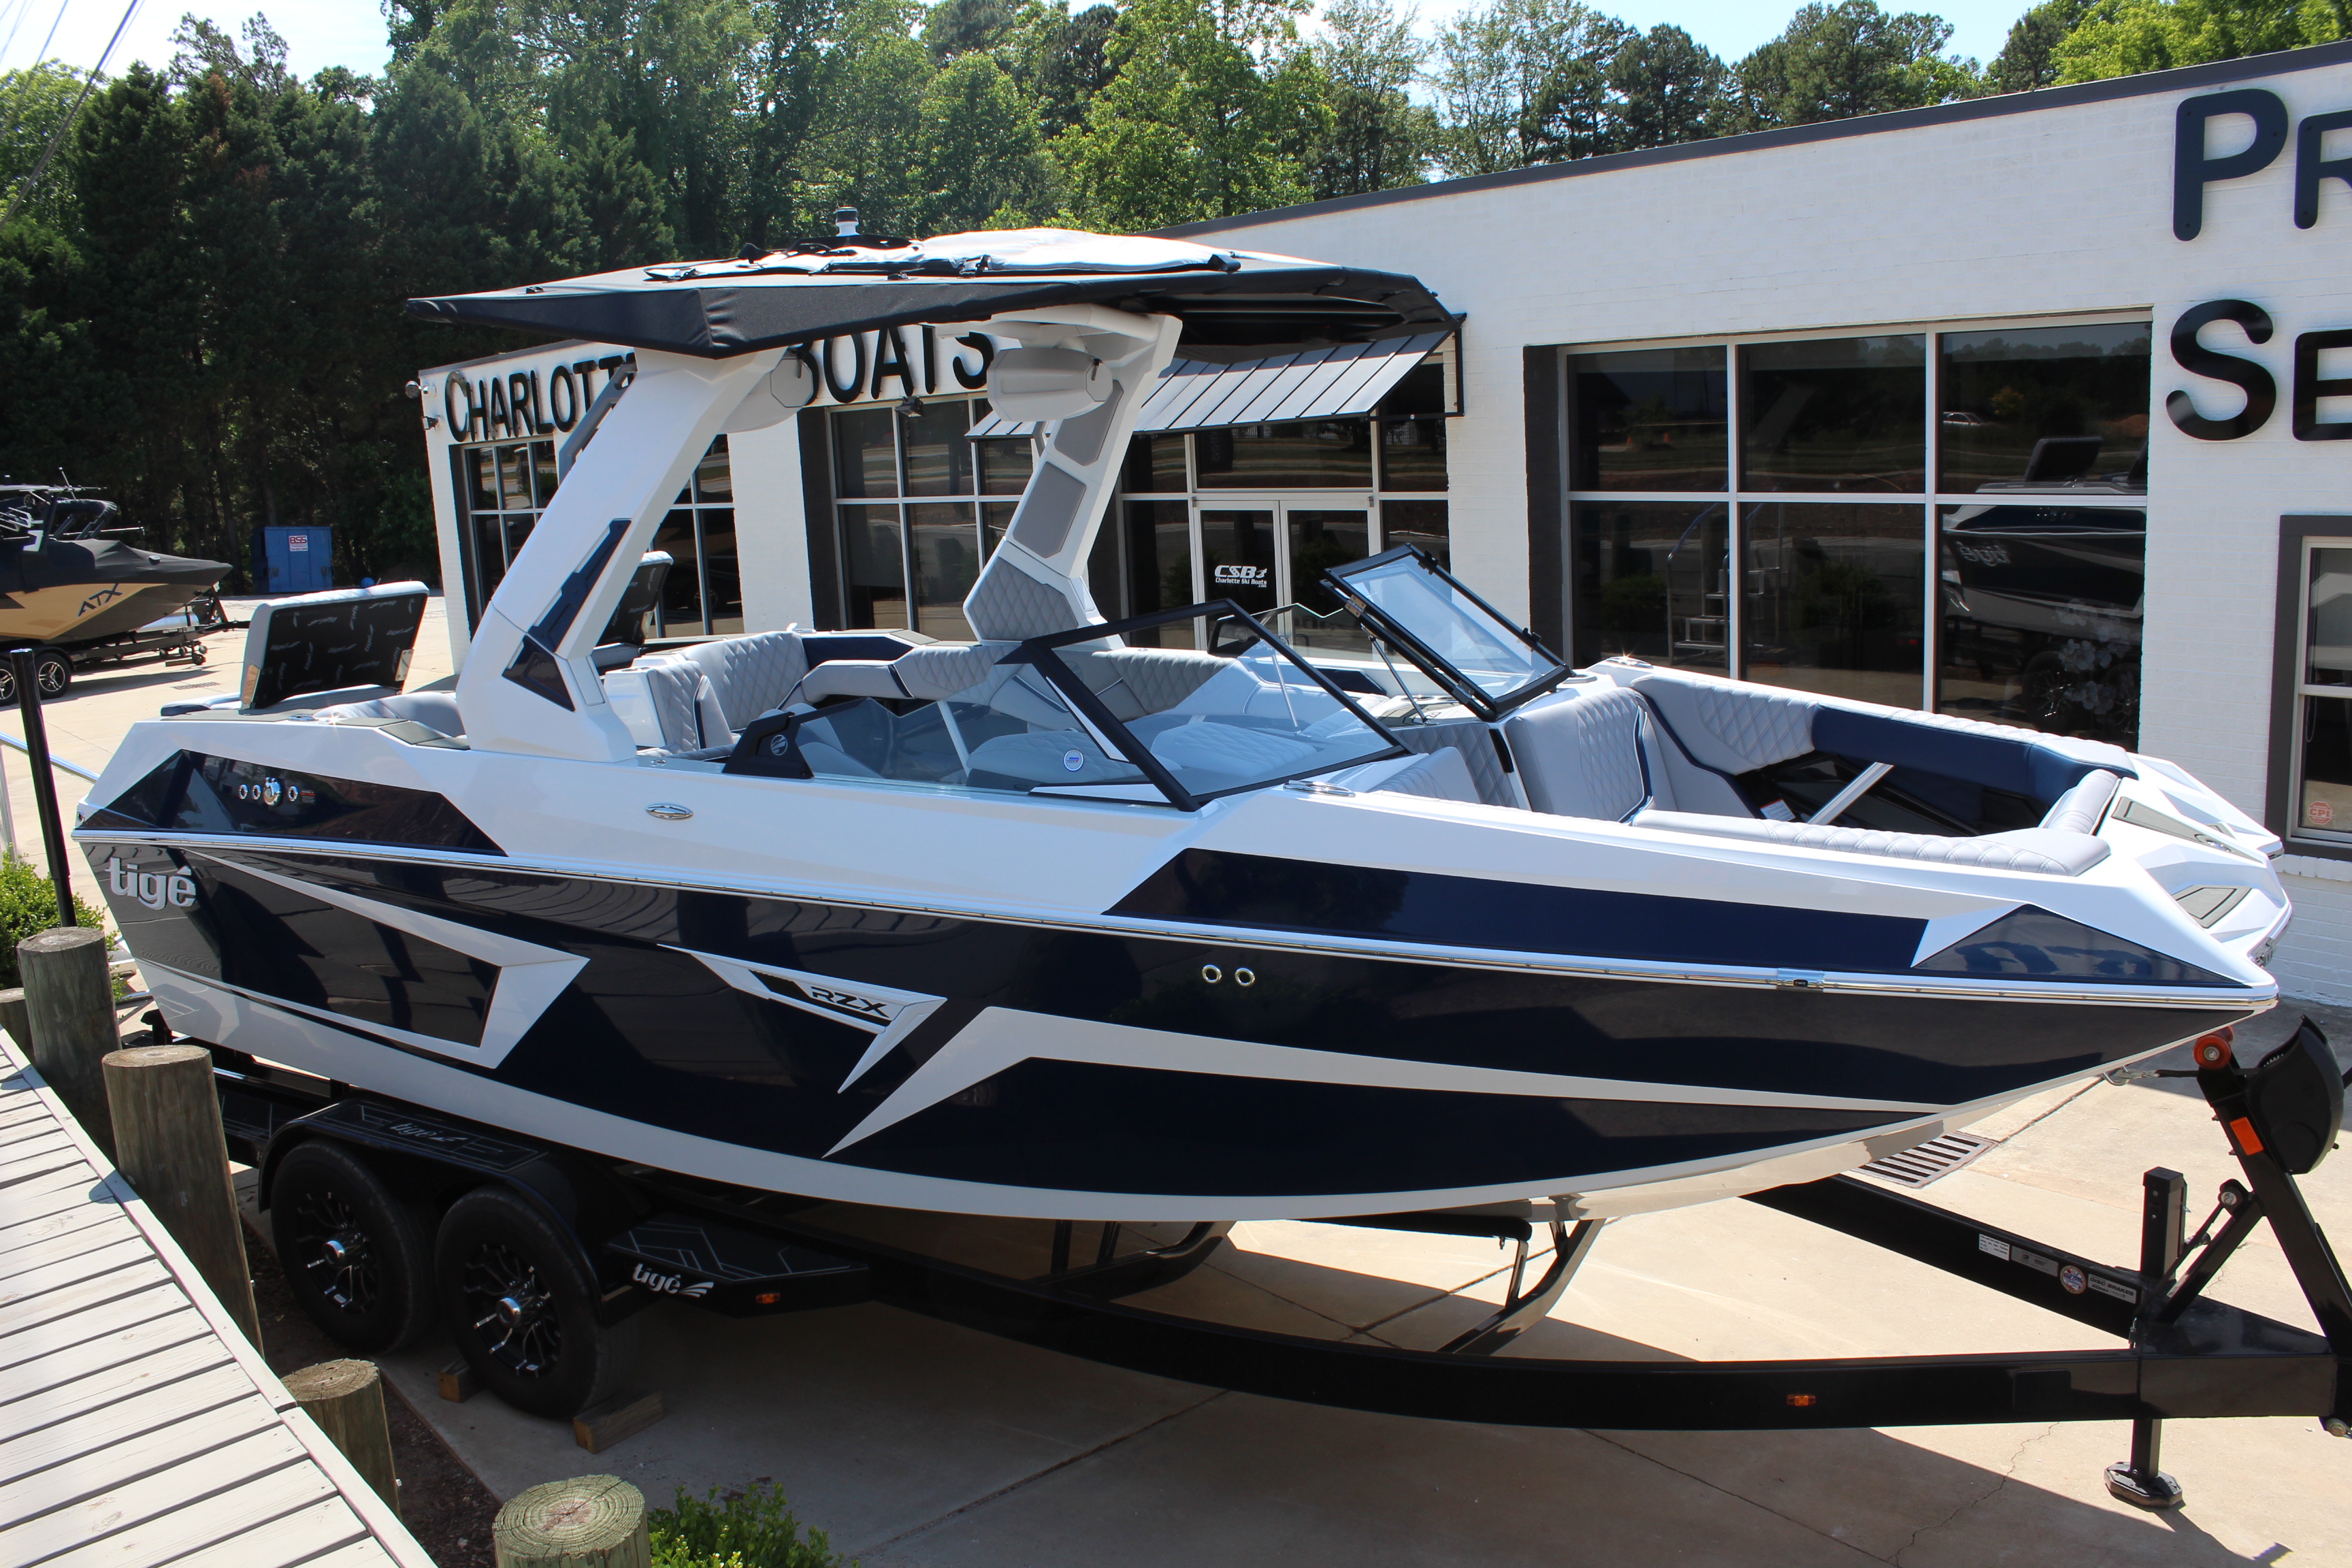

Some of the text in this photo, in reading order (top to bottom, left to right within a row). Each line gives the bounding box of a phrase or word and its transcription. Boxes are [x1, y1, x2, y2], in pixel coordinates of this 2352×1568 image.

[444, 352, 638, 442] CHARLOTT
[1214, 565, 1257, 578] CSB
[76, 583, 124, 617] ATX
[2309, 808, 2332, 819] CPI
[811, 986, 890, 1018] RZX
[2089, 1277, 2106, 1286] DISC
[2107, 1283, 2134, 1296] BRAKES
